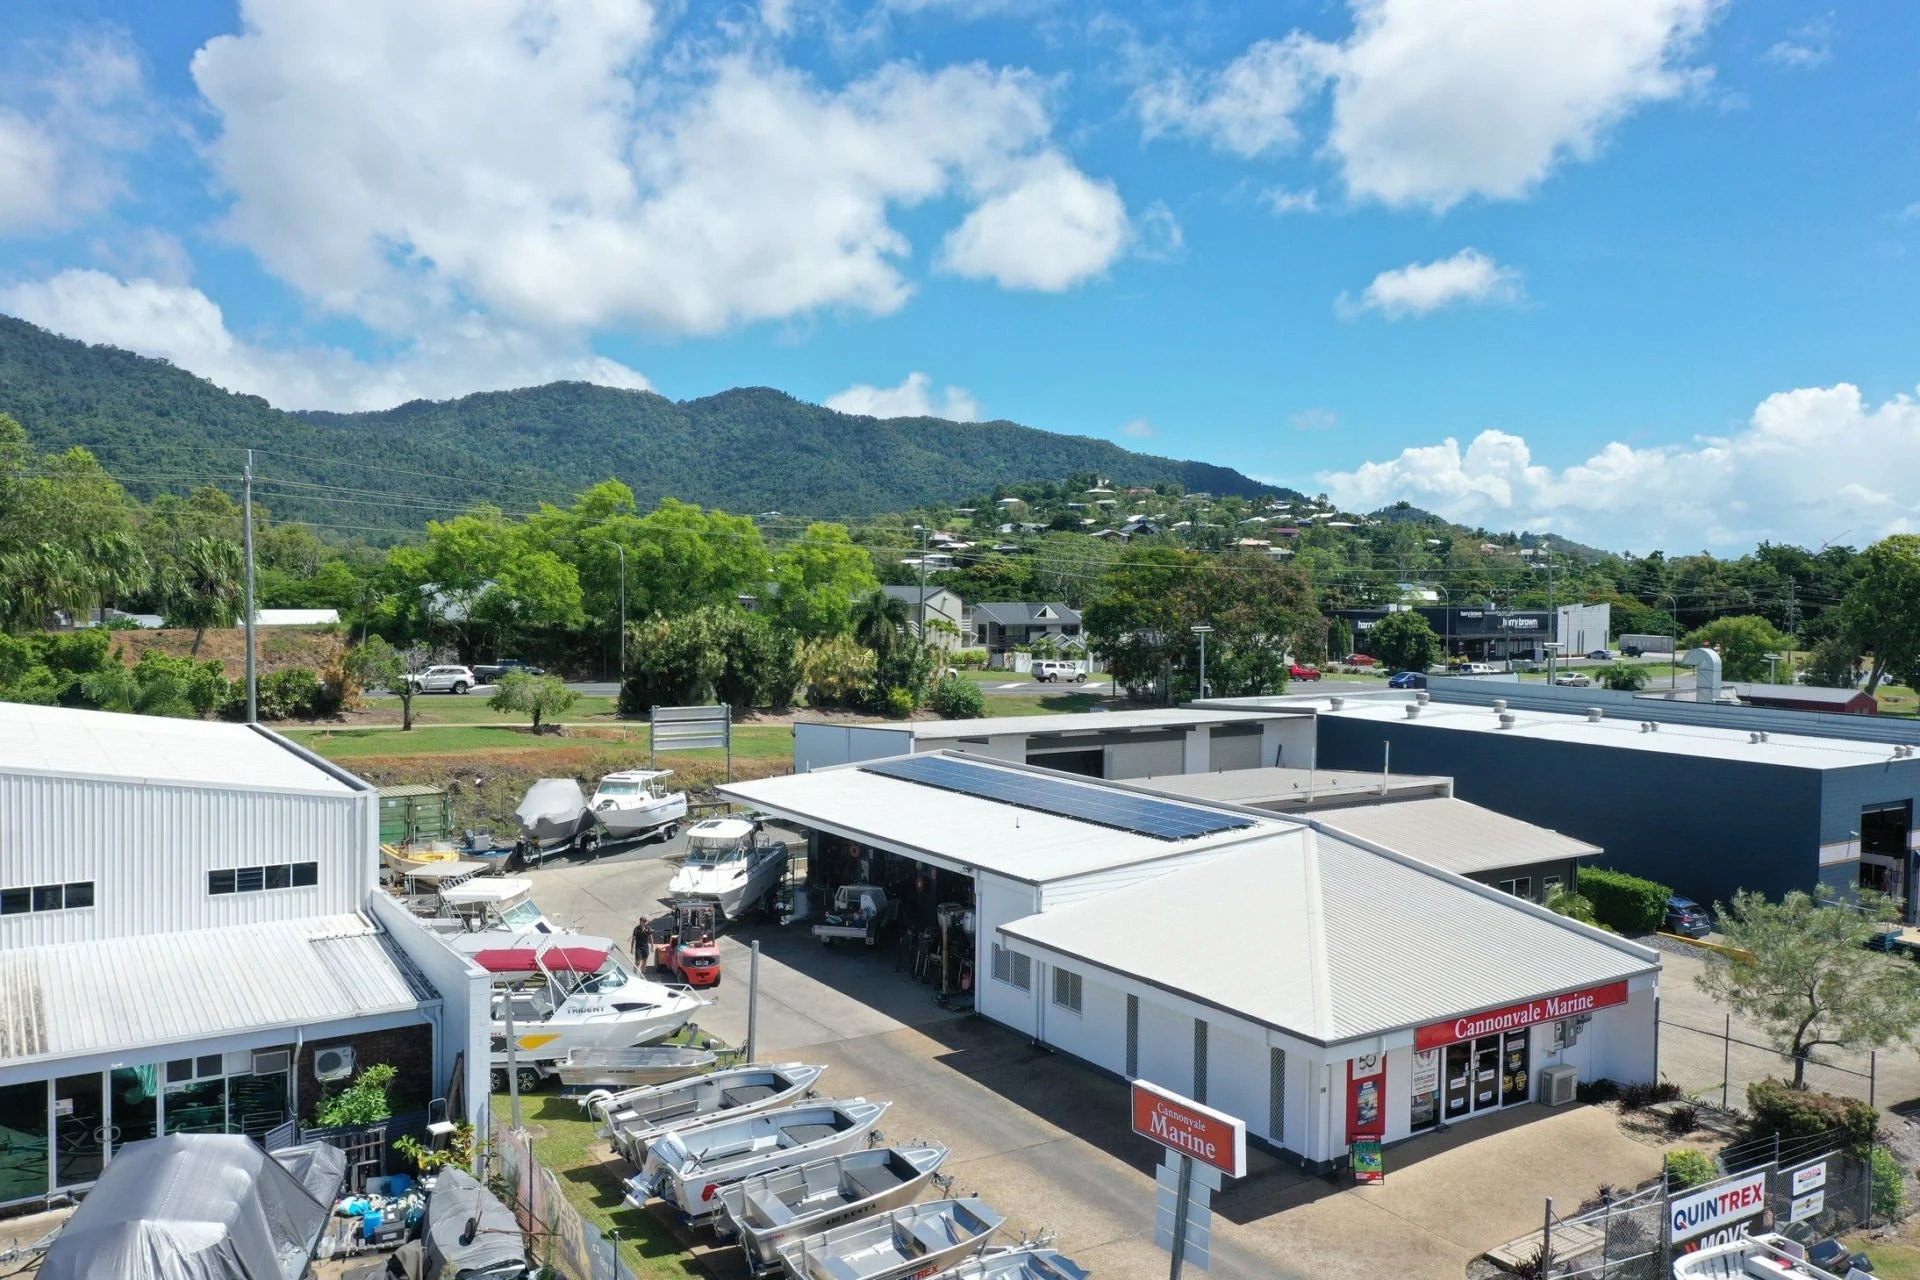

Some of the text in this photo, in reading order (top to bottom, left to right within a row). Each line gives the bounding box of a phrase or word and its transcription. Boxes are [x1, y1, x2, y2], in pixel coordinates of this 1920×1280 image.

[1519, 618, 1538, 626] brown
[1454, 994, 1594, 1039] Cannonvale Marine
[1150, 1110, 1217, 1159] Marine
[1157, 1102, 1206, 1132] Cannonvale
[666, 1140, 684, 1162] HONDA
[1673, 1182, 1763, 1231] QUINTREX
